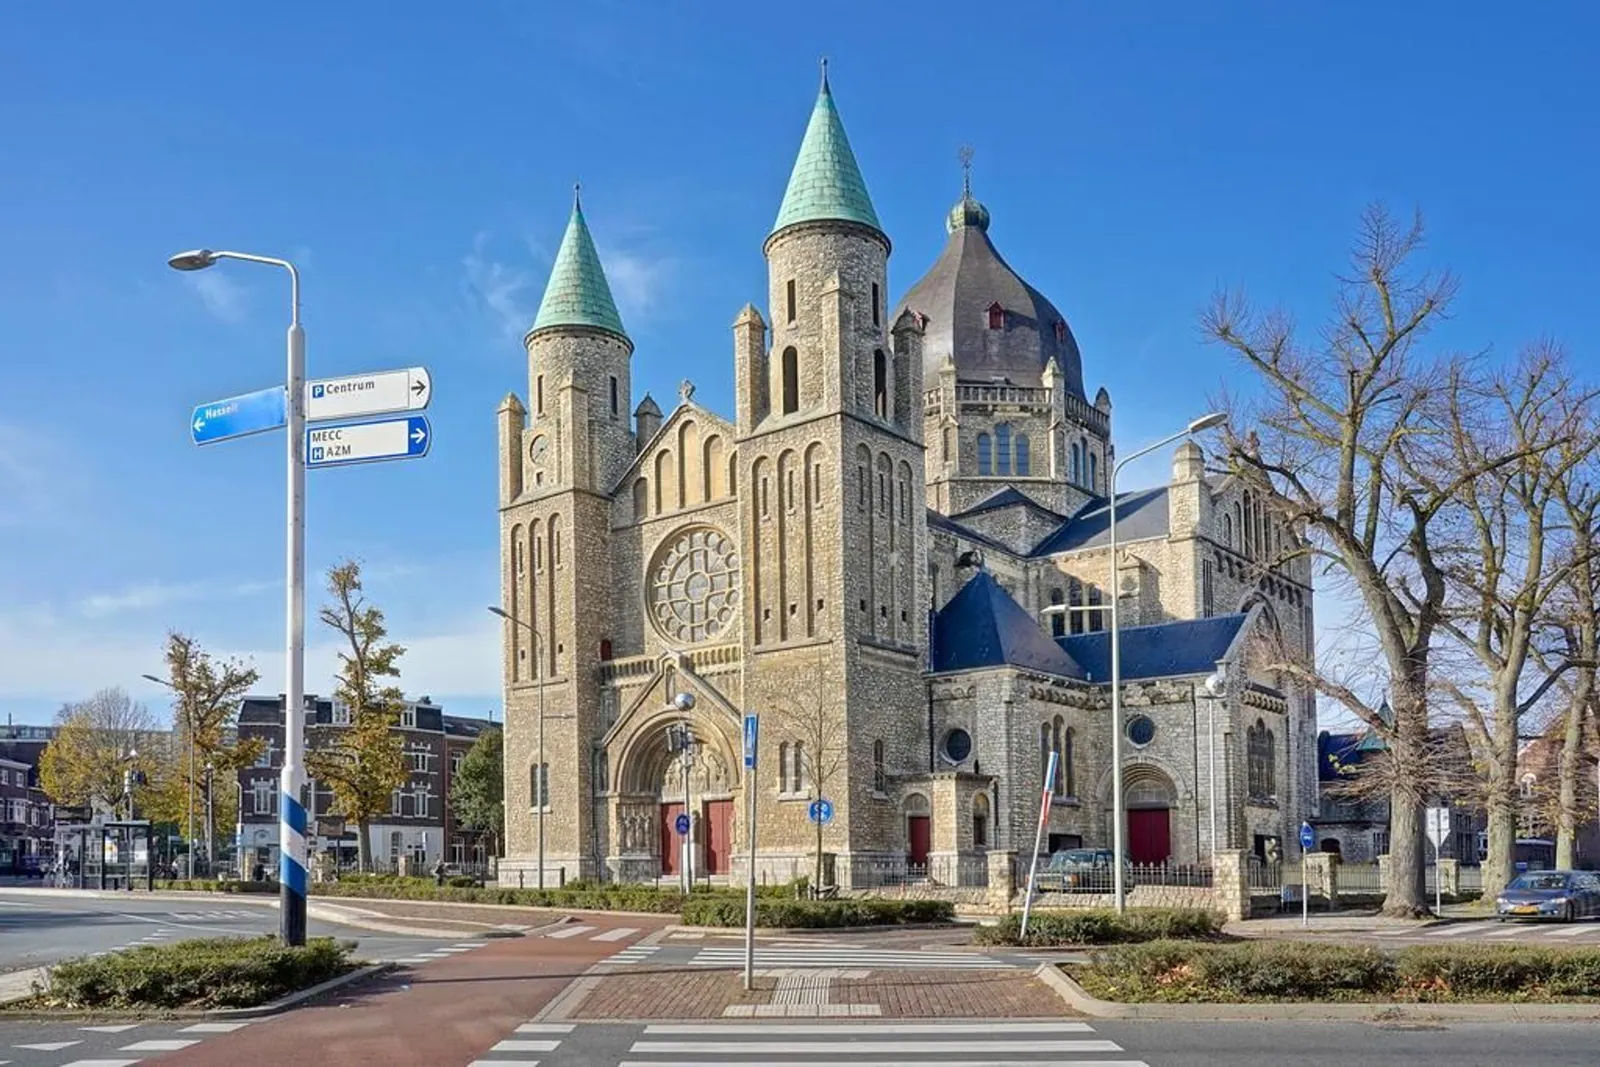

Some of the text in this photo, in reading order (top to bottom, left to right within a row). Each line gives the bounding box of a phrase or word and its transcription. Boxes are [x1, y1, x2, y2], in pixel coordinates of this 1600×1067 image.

[314, 381, 375, 398] P Centrum
[312, 430, 343, 442] MECC
[313, 445, 351, 460] H AZM
